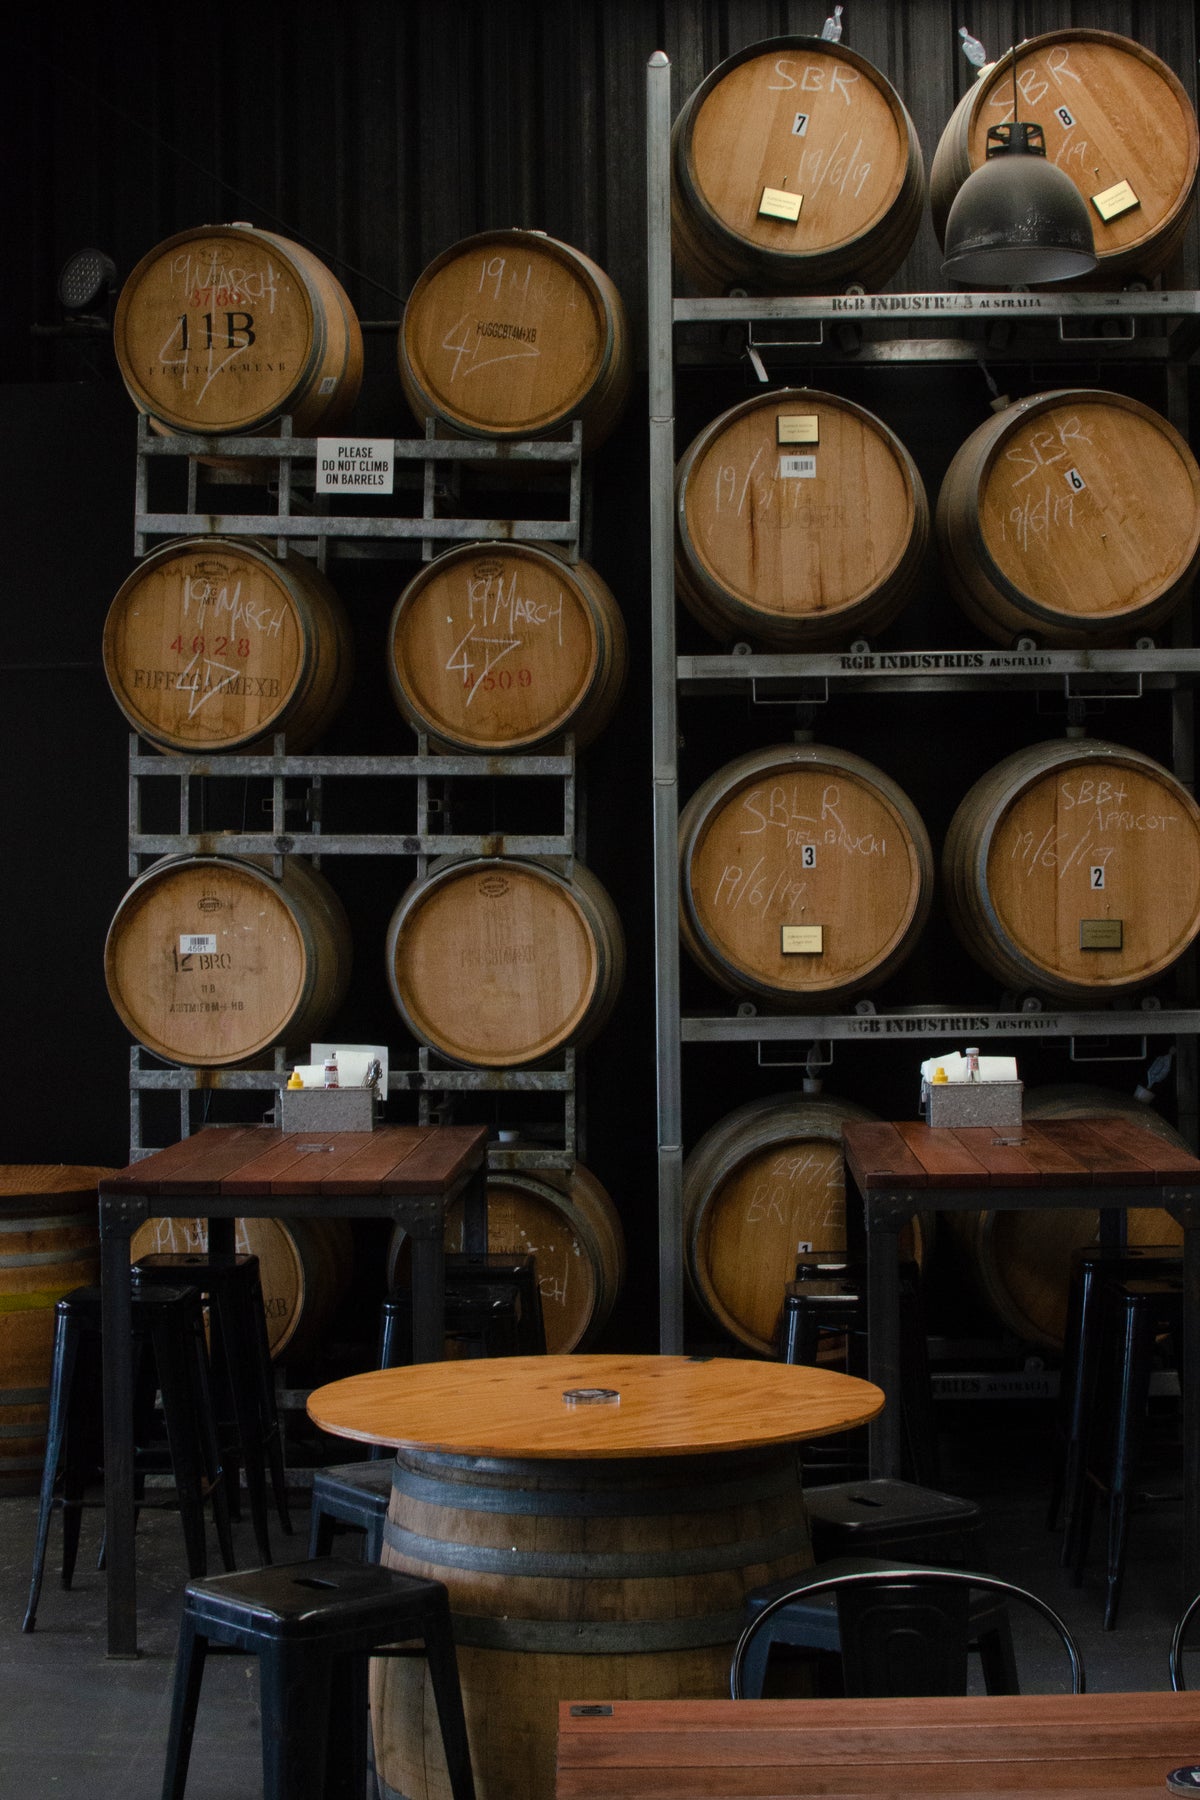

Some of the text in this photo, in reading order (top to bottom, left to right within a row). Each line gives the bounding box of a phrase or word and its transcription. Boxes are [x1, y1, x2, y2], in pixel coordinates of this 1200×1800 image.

[768, 60, 859, 106] SBR
[796, 116, 806, 133] 7
[1058, 109, 1072, 126] 8
[479, 256, 506, 300] 19
[338, 446, 374, 458] PLEASE
[322, 460, 389, 472] DO NOT CLIMB
[326, 473, 384, 486] ON BARRELS
[1070, 472, 1082, 489] 6
[184, 575, 288, 641] 19 MARCH
[493, 571, 563, 647] MARCH
[170, 635, 251, 659] 4628
[880, 653, 984, 669] INDUSTRIES
[989, 656, 1053, 667] AUSTRALIA
[1088, 806, 1178, 832] APRICOT
[805, 847, 814, 866] 3
[1094, 868, 1103, 887] 2
[886, 1017, 990, 1032] INDUSTRIES
